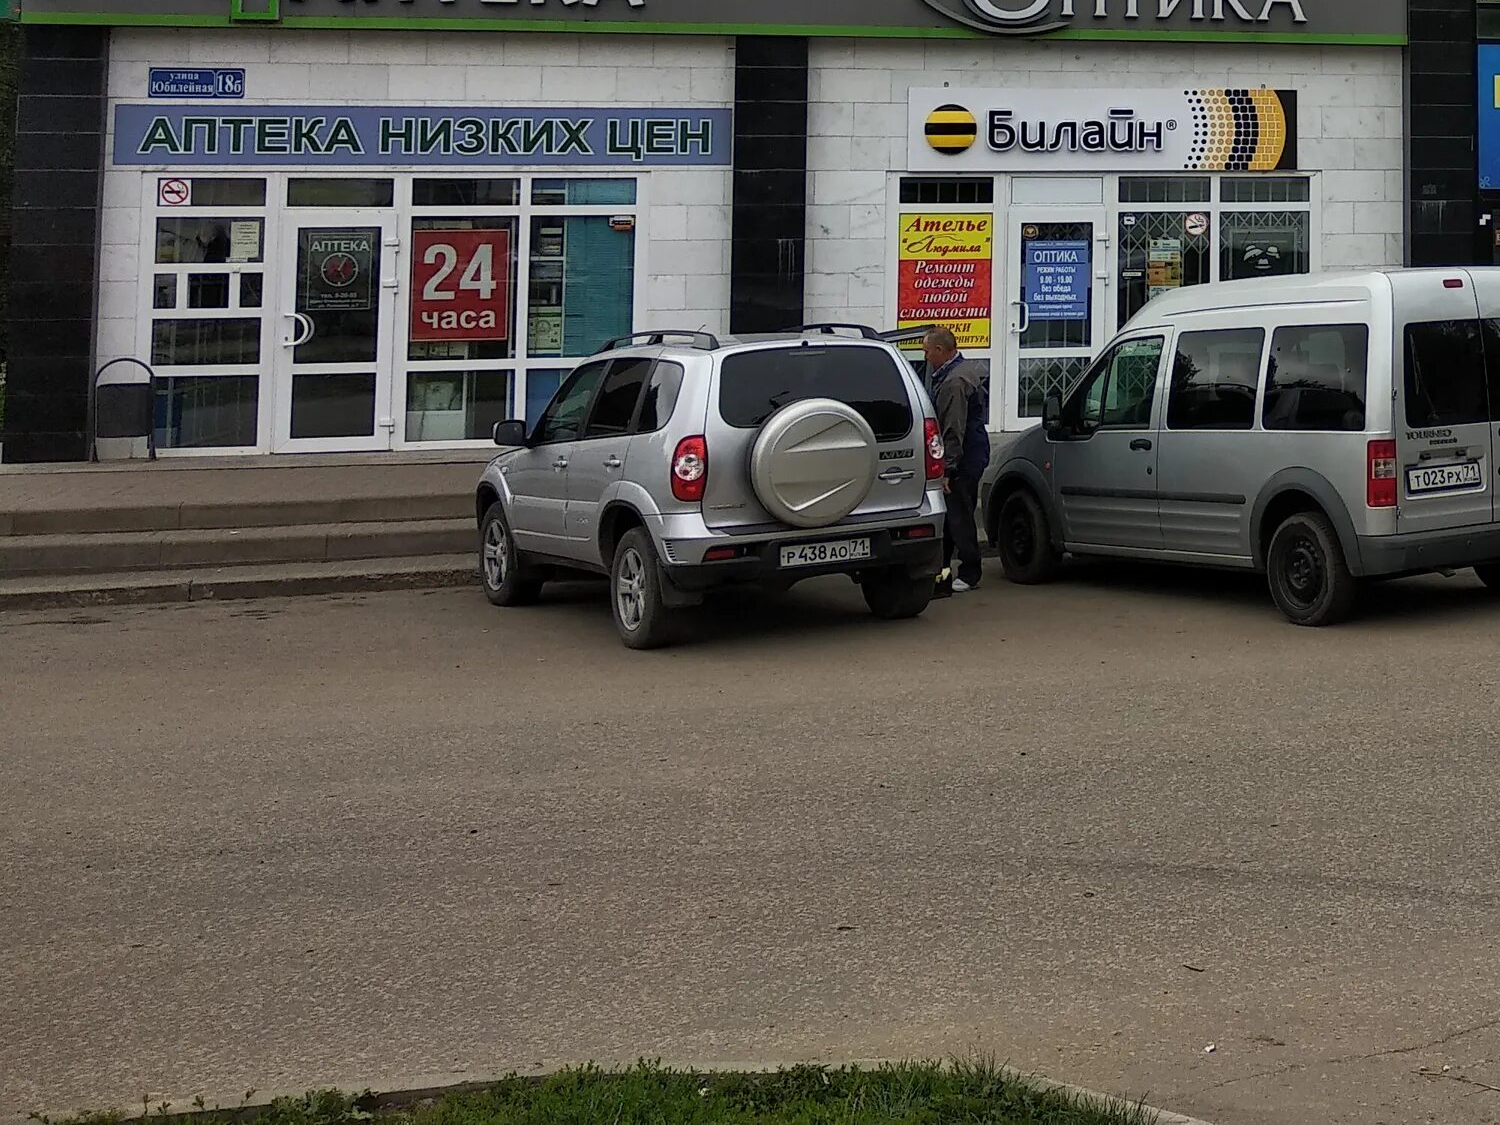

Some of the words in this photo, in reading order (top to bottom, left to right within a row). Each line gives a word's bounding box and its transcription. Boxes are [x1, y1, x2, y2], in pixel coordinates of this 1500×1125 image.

[168, 72, 200, 81] улица
[151, 80, 214, 94] Юбилейная
[137, 116, 365, 155] АПТЕКА
[379, 117, 594, 156] НИЗКИХ
[606, 119, 713, 162] ЦЕН
[905, 215, 988, 233] Ателье
[311, 240, 371, 252] АПТЕКА
[1033, 250, 1079, 263] ОПТИКА
[422, 243, 497, 301] 24
[914, 260, 975, 274] Ремонт
[914, 275, 975, 289] одежды
[1041, 284, 1052, 292] без
[1052, 284, 1072, 293] обеда
[919, 290, 968, 303] любой
[1033, 293, 1044, 301] без
[1045, 293, 1077, 302] выходных
[900, 306, 988, 319] сложности
[421, 310, 497, 331] часа
[1414, 469, 1462, 488] Т023РХ
[1463, 465, 1476, 477] 71
[786, 544, 848, 564] Р438АО
[850, 539, 867, 552] 71
